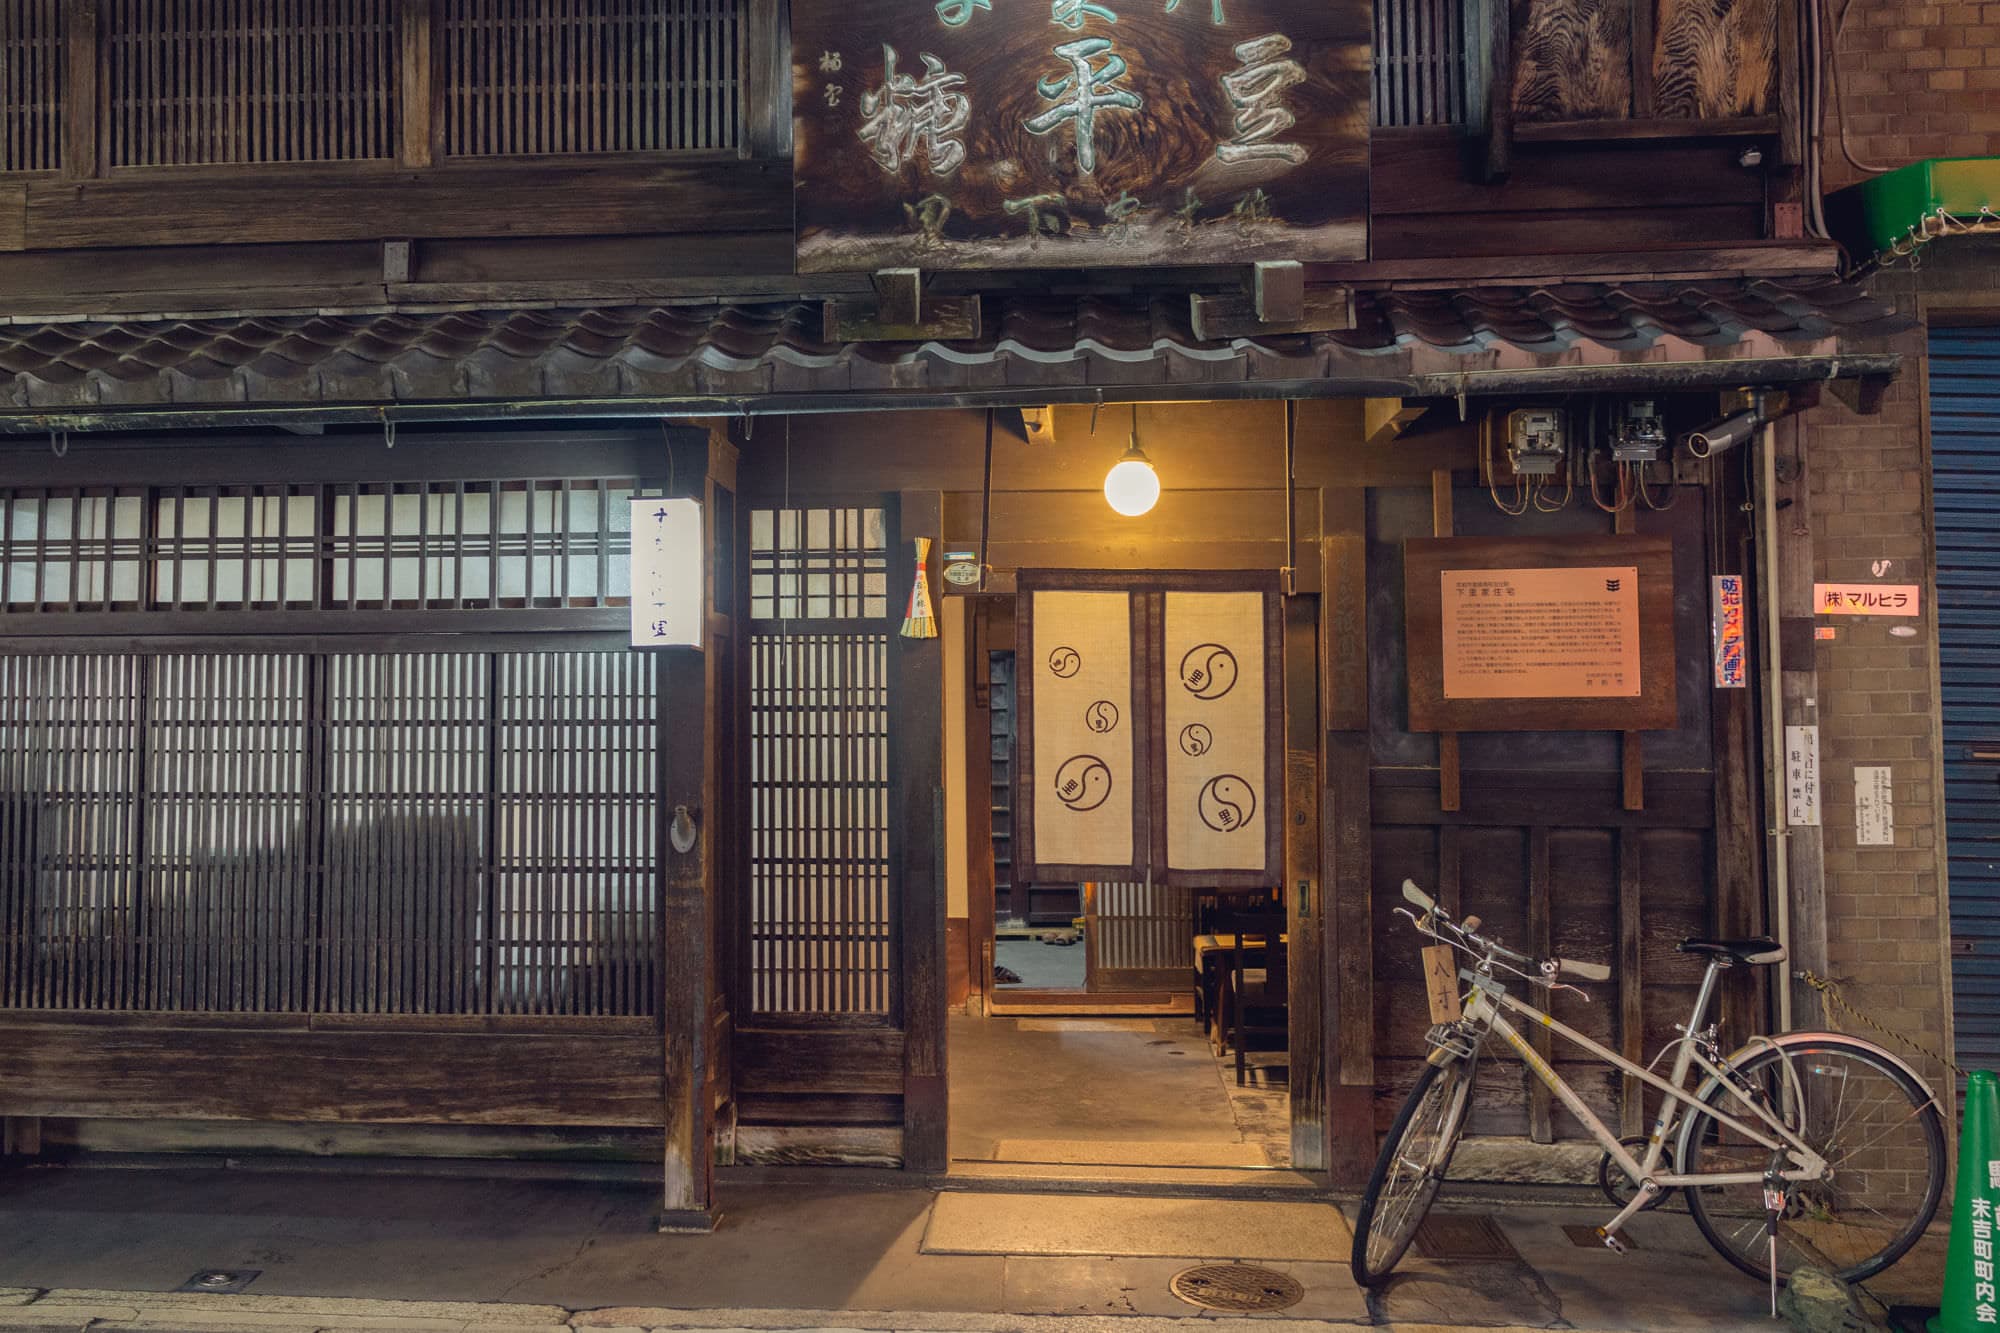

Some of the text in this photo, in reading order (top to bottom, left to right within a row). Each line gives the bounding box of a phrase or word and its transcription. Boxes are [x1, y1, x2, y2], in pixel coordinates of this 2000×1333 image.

[1791, 750, 1801, 818] 駐車禁止
[1971, 1197, 1997, 1324] 末吉町町内会
